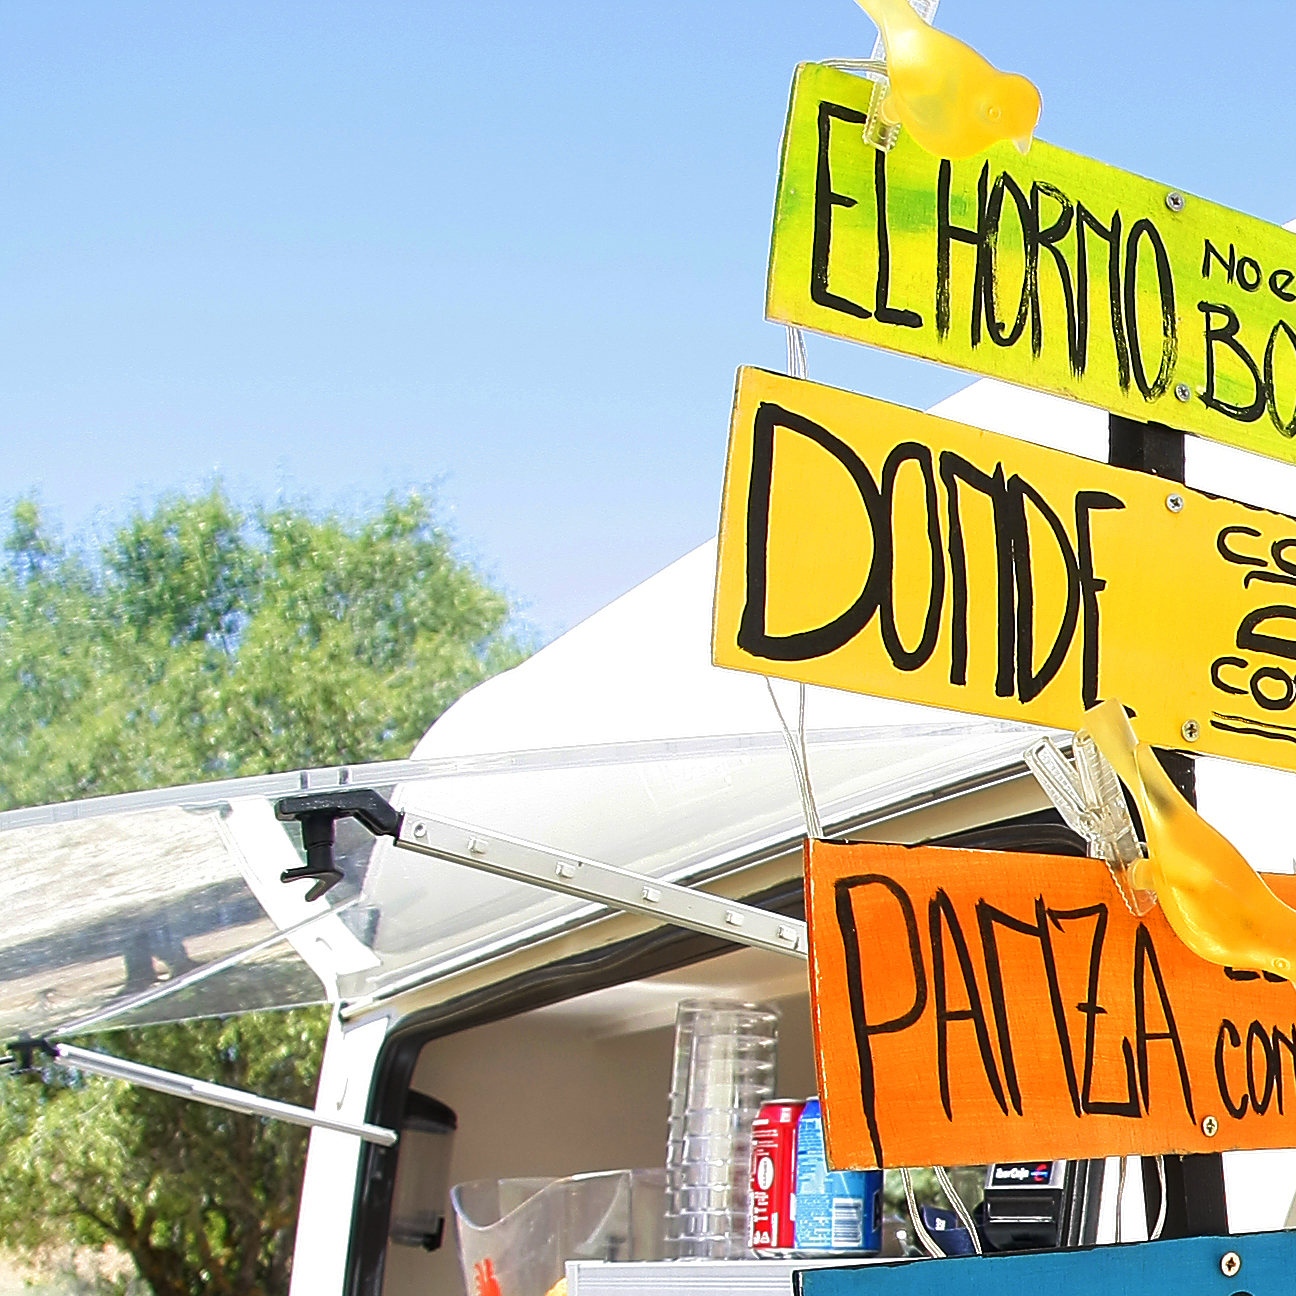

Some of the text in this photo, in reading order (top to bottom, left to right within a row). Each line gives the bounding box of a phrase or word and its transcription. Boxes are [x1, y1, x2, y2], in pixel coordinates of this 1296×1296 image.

[811, 100, 1178, 402] EL HORNO
[737, 401, 1138, 718] DONDE
[835, 873, 1197, 1168] PANZA
